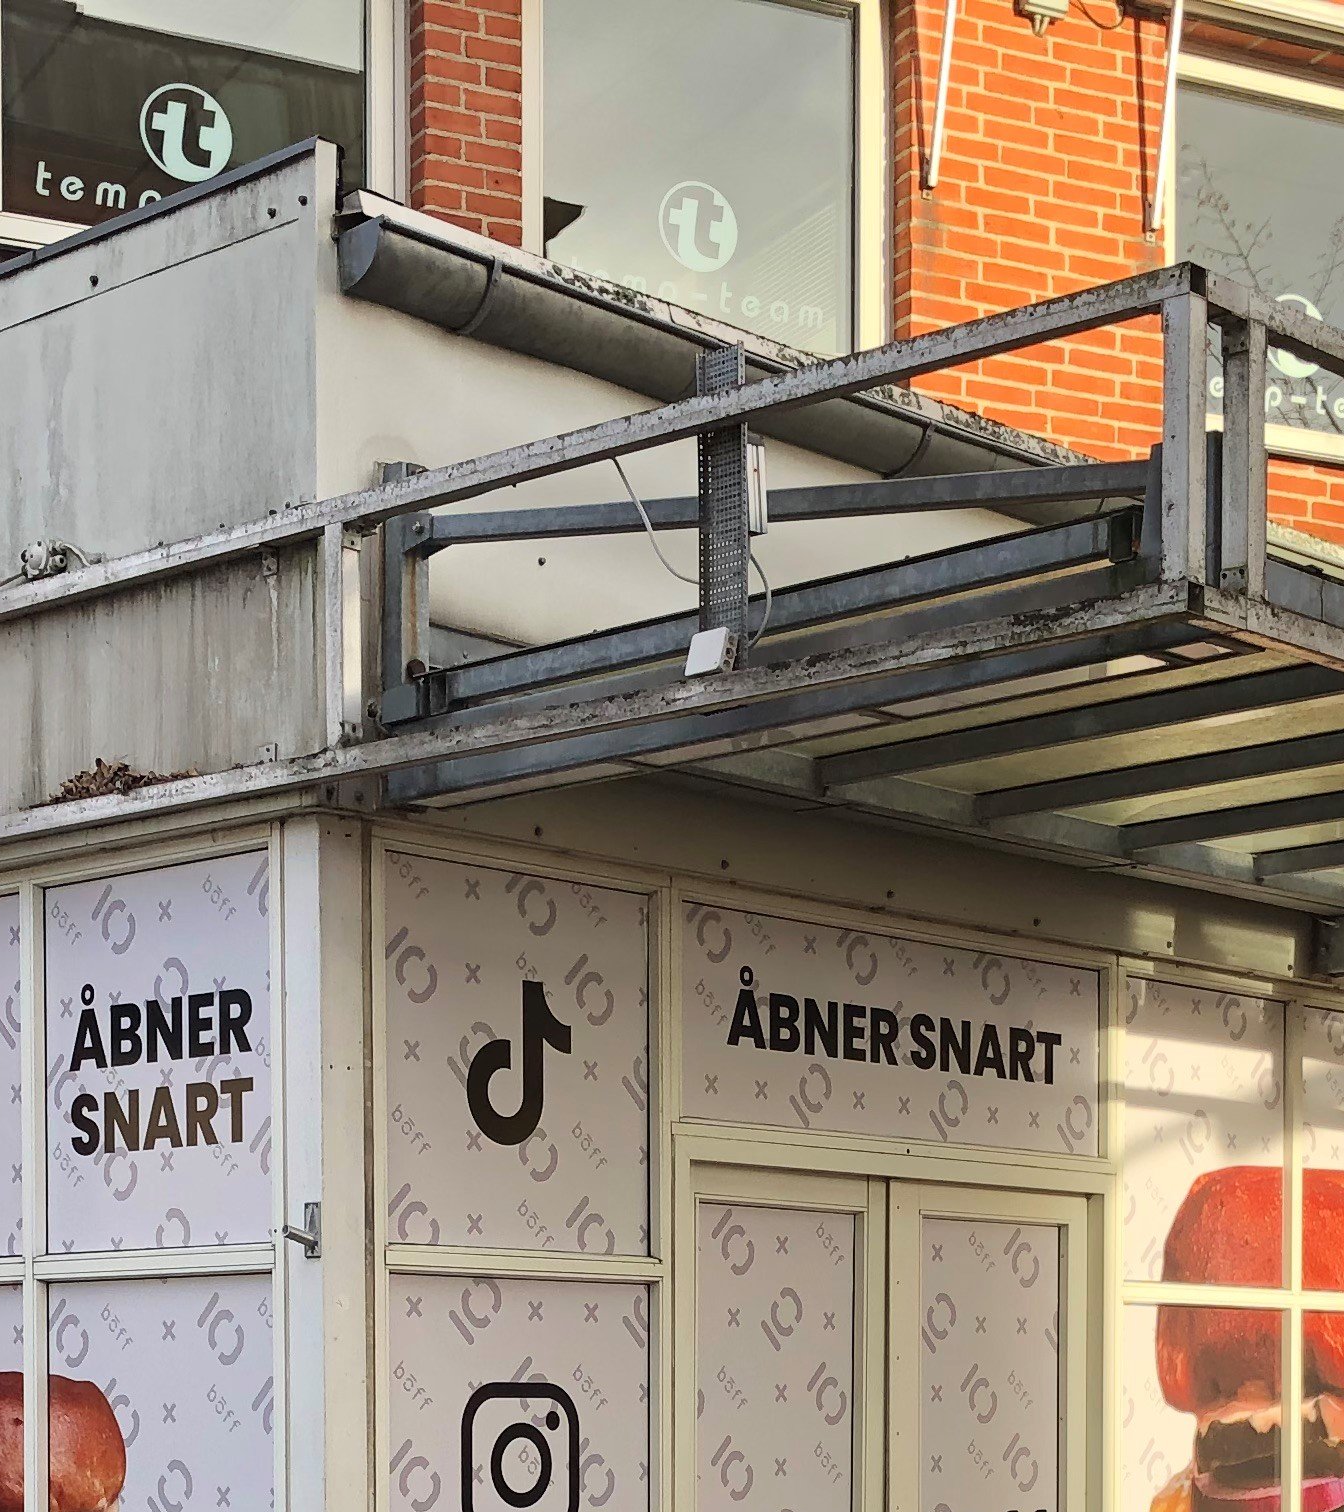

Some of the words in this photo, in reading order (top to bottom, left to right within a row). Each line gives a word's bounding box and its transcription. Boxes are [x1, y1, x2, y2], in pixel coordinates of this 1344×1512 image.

[69, 983, 253, 1072] ÅBNER
[727, 965, 899, 1066] ÅBNER
[909, 1013, 1062, 1085] SNART
[71, 1077, 254, 1156] SNART
